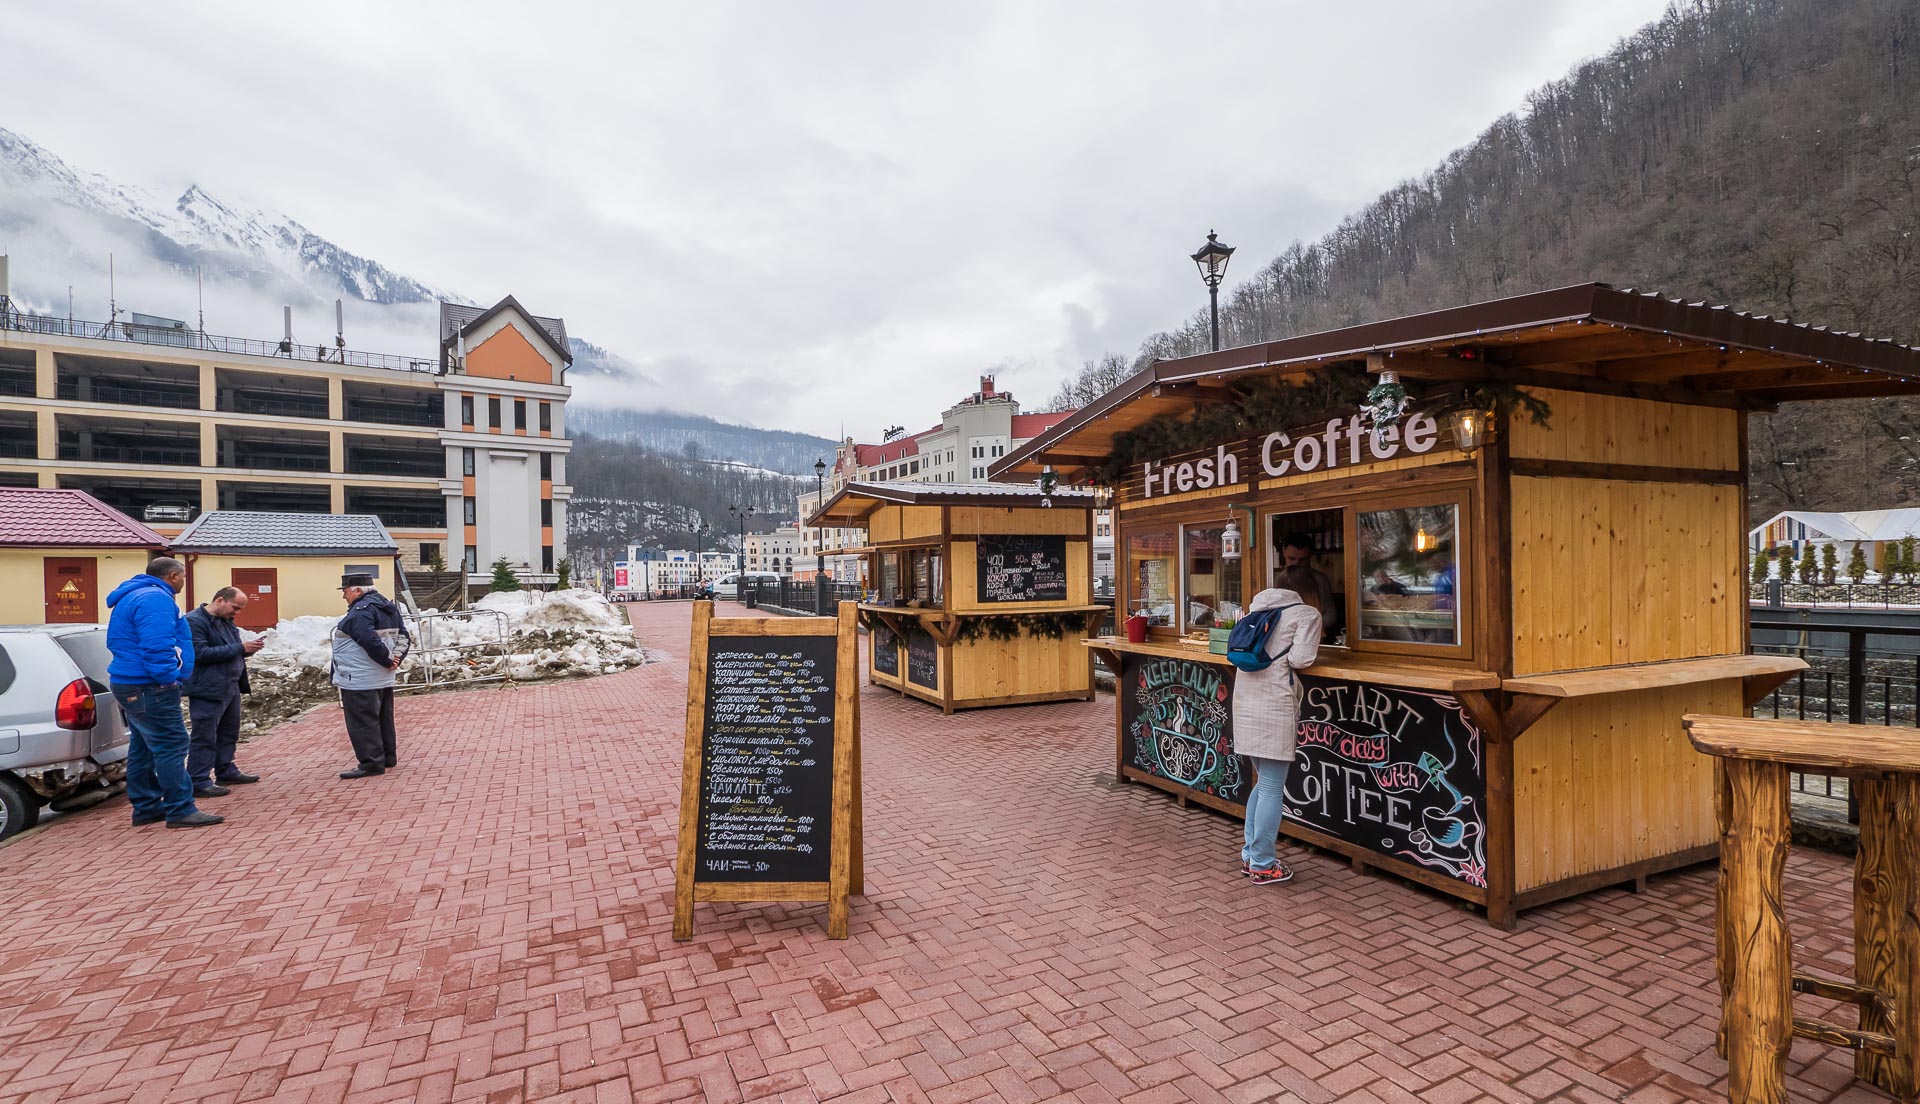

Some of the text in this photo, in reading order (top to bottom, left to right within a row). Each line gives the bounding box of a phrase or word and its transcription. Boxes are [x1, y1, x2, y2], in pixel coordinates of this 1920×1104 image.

[1145, 413, 1437, 498] Fresh Coffee
[1143, 661, 1219, 701] KEEP CALM
[1308, 686, 1424, 743] START
[1340, 736, 1385, 760] day
[734, 784, 767, 794] ЛАТТЕ
[1376, 764, 1419, 788] with
